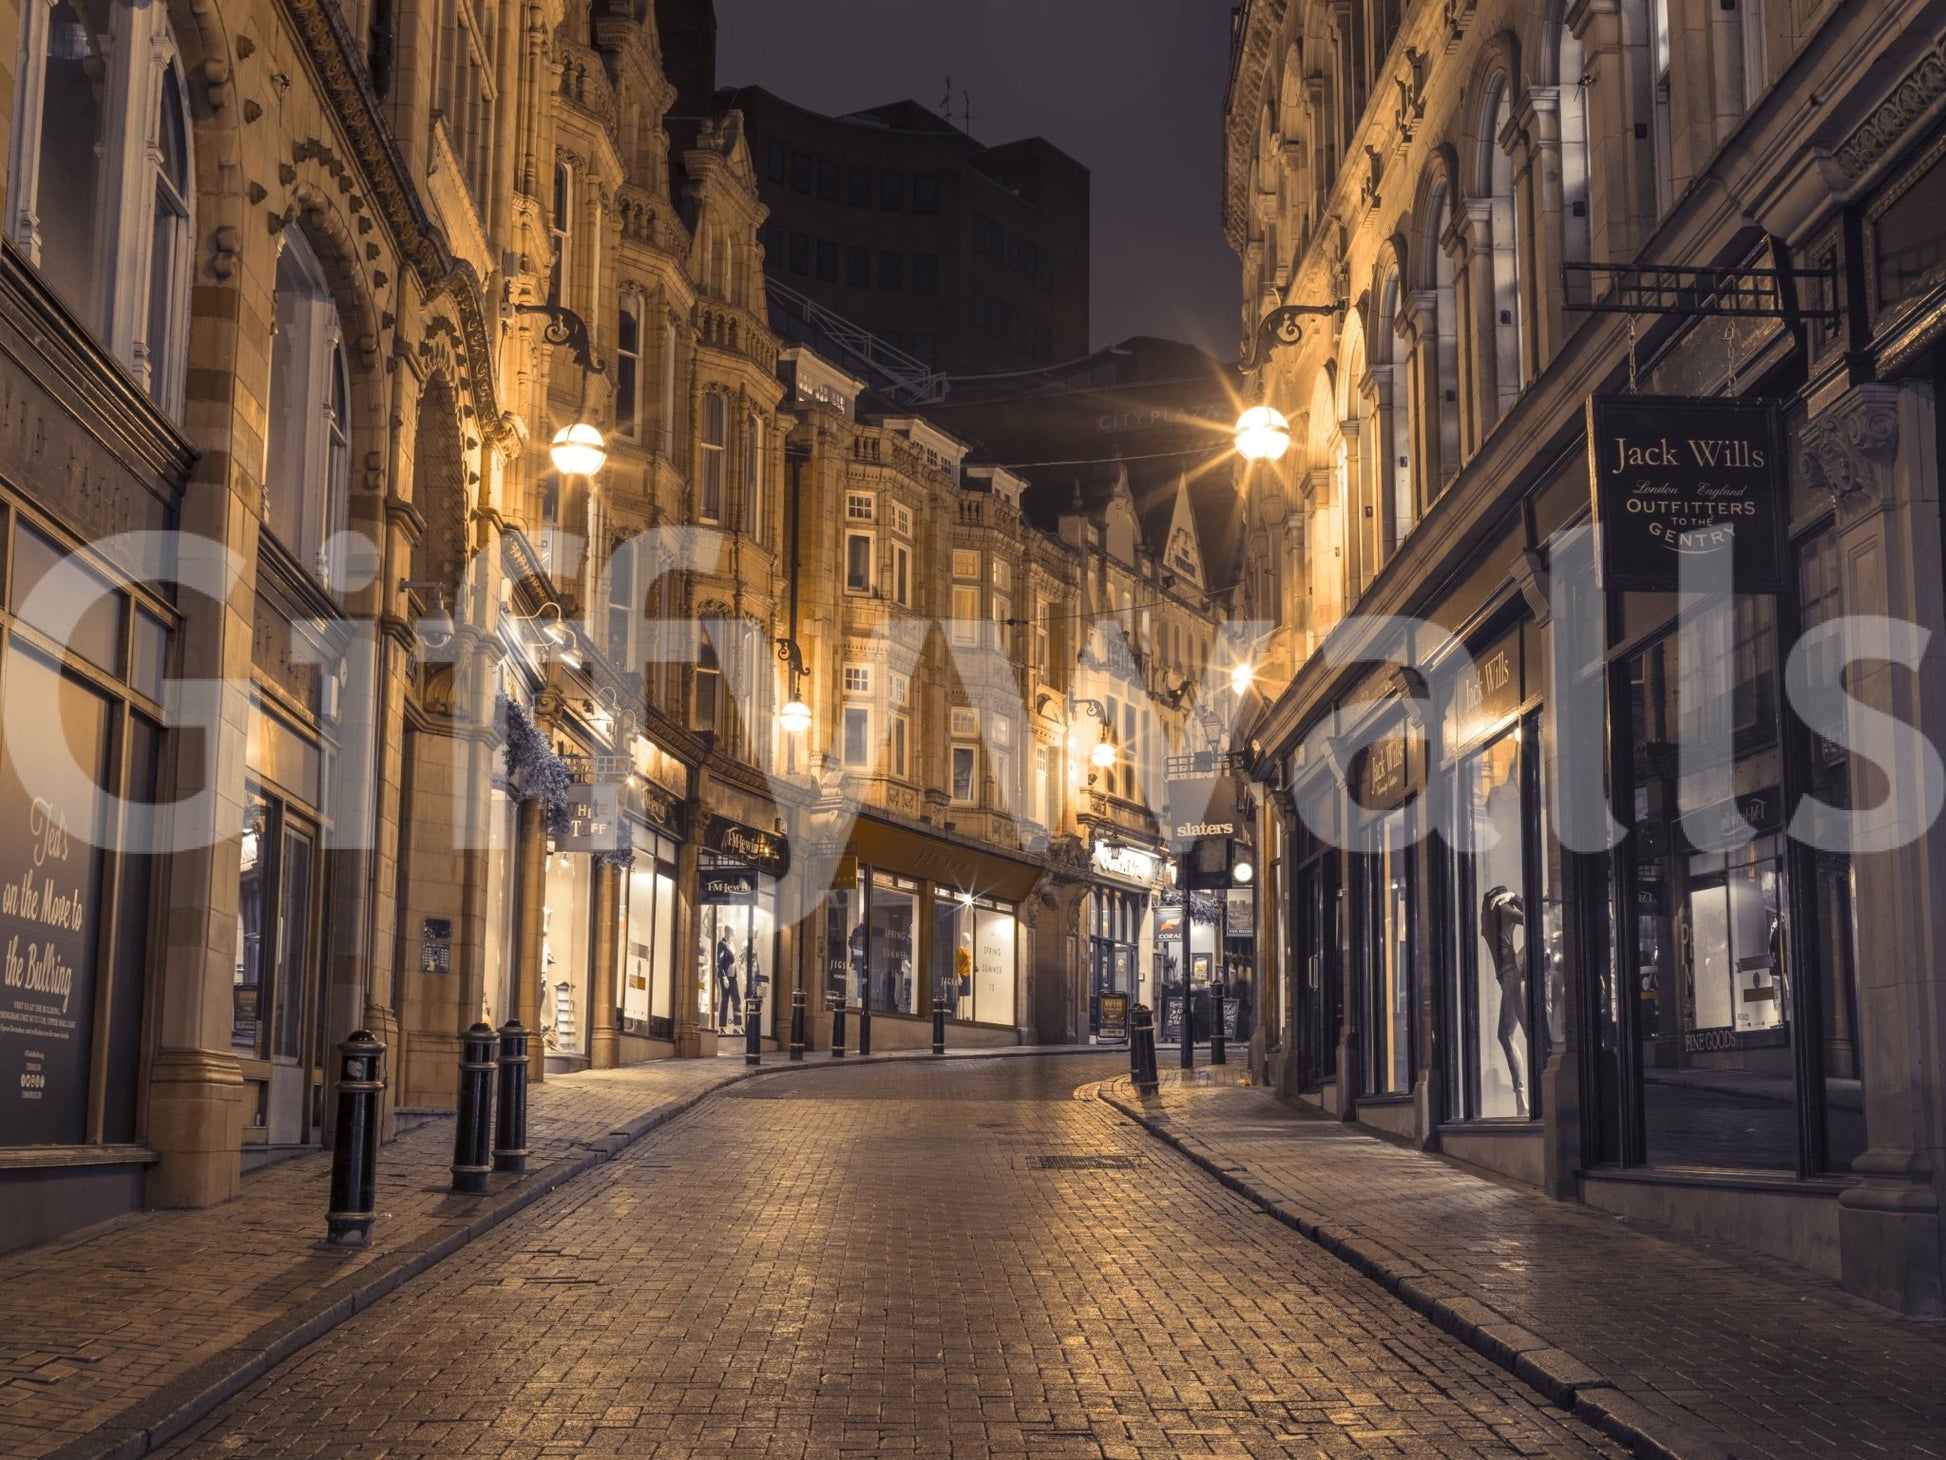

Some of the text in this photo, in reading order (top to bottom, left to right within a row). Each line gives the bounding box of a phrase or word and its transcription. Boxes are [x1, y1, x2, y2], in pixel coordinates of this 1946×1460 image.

[1612, 437, 1765, 475] Jack Wills
[1631, 480, 1746, 500] London England
[1626, 498, 1756, 515] OUTFITTERS
[1671, 516, 1713, 526] TO THE
[1649, 522, 1736, 547] GENTRY
[1465, 650, 1509, 713] Jack Wills
[30, 796, 69, 867] Ted's
[1177, 822, 1234, 837] slaters
[3, 868, 82, 932] on the Move to
[5, 934, 72, 1014] the Bullring
[1685, 1030, 1736, 1053] FINE GOODS
